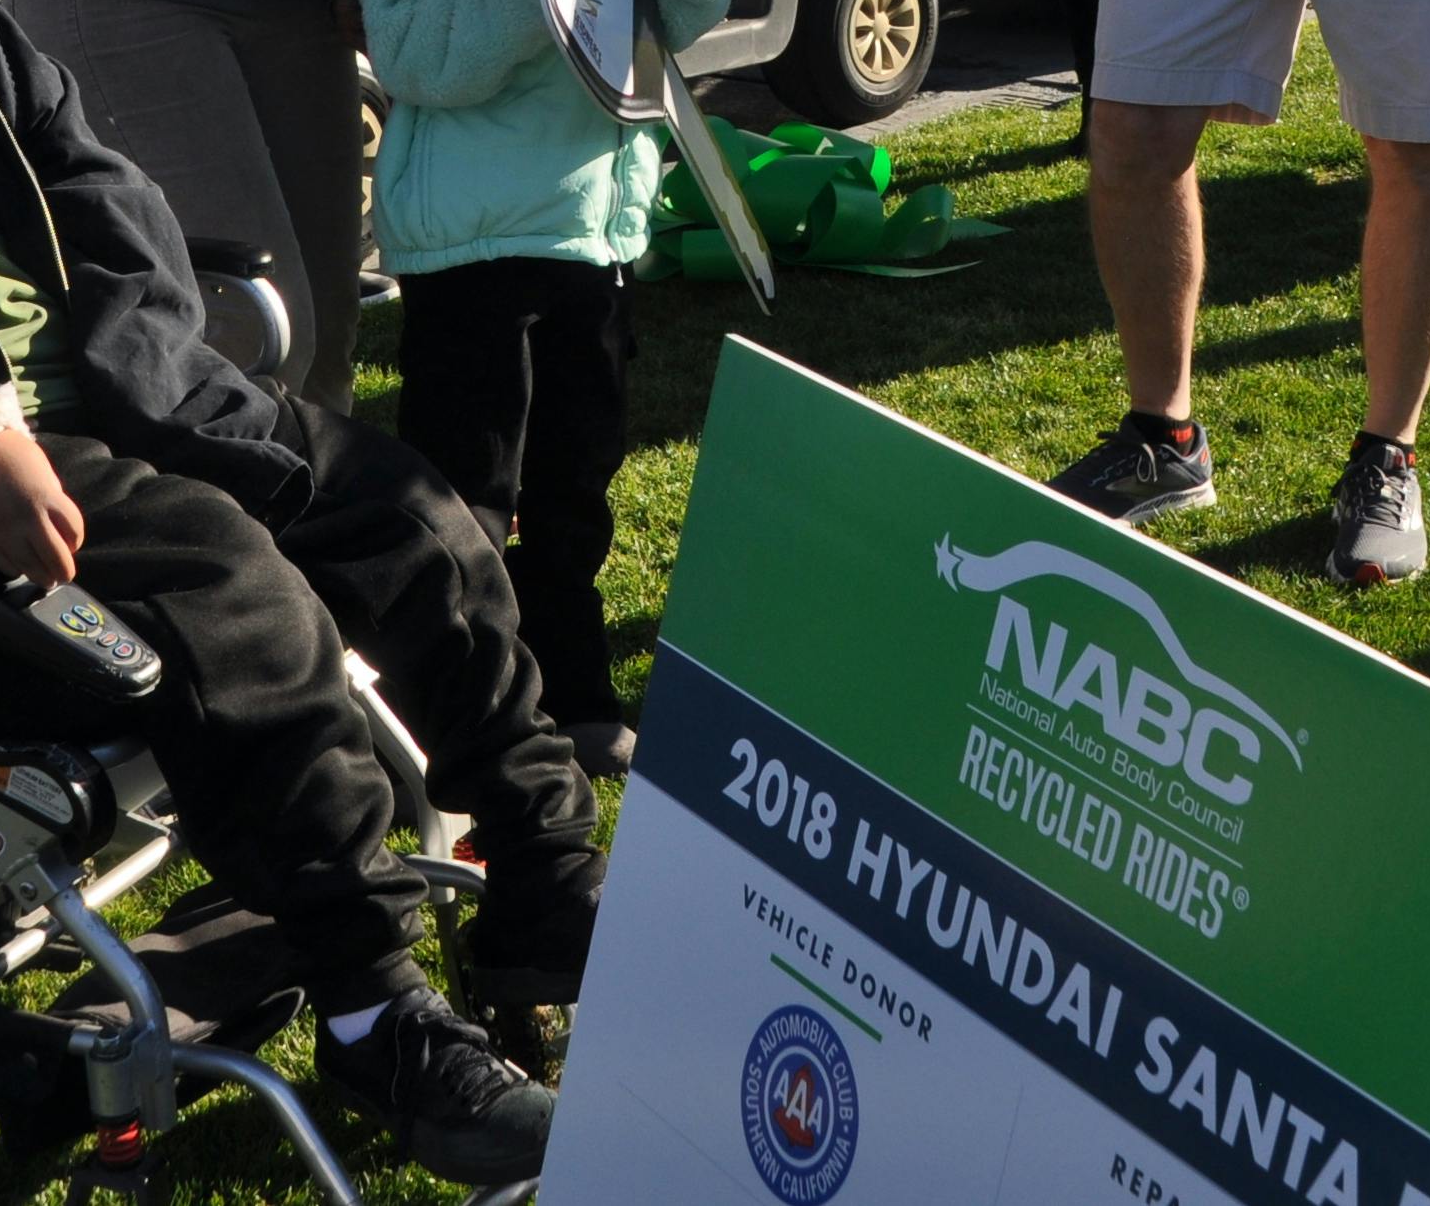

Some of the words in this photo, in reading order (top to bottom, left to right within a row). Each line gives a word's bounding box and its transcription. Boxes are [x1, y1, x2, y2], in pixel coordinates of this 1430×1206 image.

[979, 672, 1056, 736] National
[1059, 723, 1105, 765] Auto
[1111, 748, 1163, 803] Body
[1167, 781, 1244, 845] Council
[984, 594, 1261, 806] NABC
[958, 724, 1123, 873] RECYCLED
[721, 738, 838, 861] 2018
[846, 817, 1124, 1059] HYUNDAI
[1134, 1016, 1359, 1206] SANTA
[743, 883, 834, 970] VEHICLE
[842, 958, 933, 1044] DONOR
[745, 1062, 782, 1184] SOUTHERN
[780, 1136, 852, 1202] CALIFORNIA
[758, 1013, 839, 1065] AUTOMOBILE
[832, 1061, 854, 1122] CLUB
[773, 1069, 823, 1135] AAA
